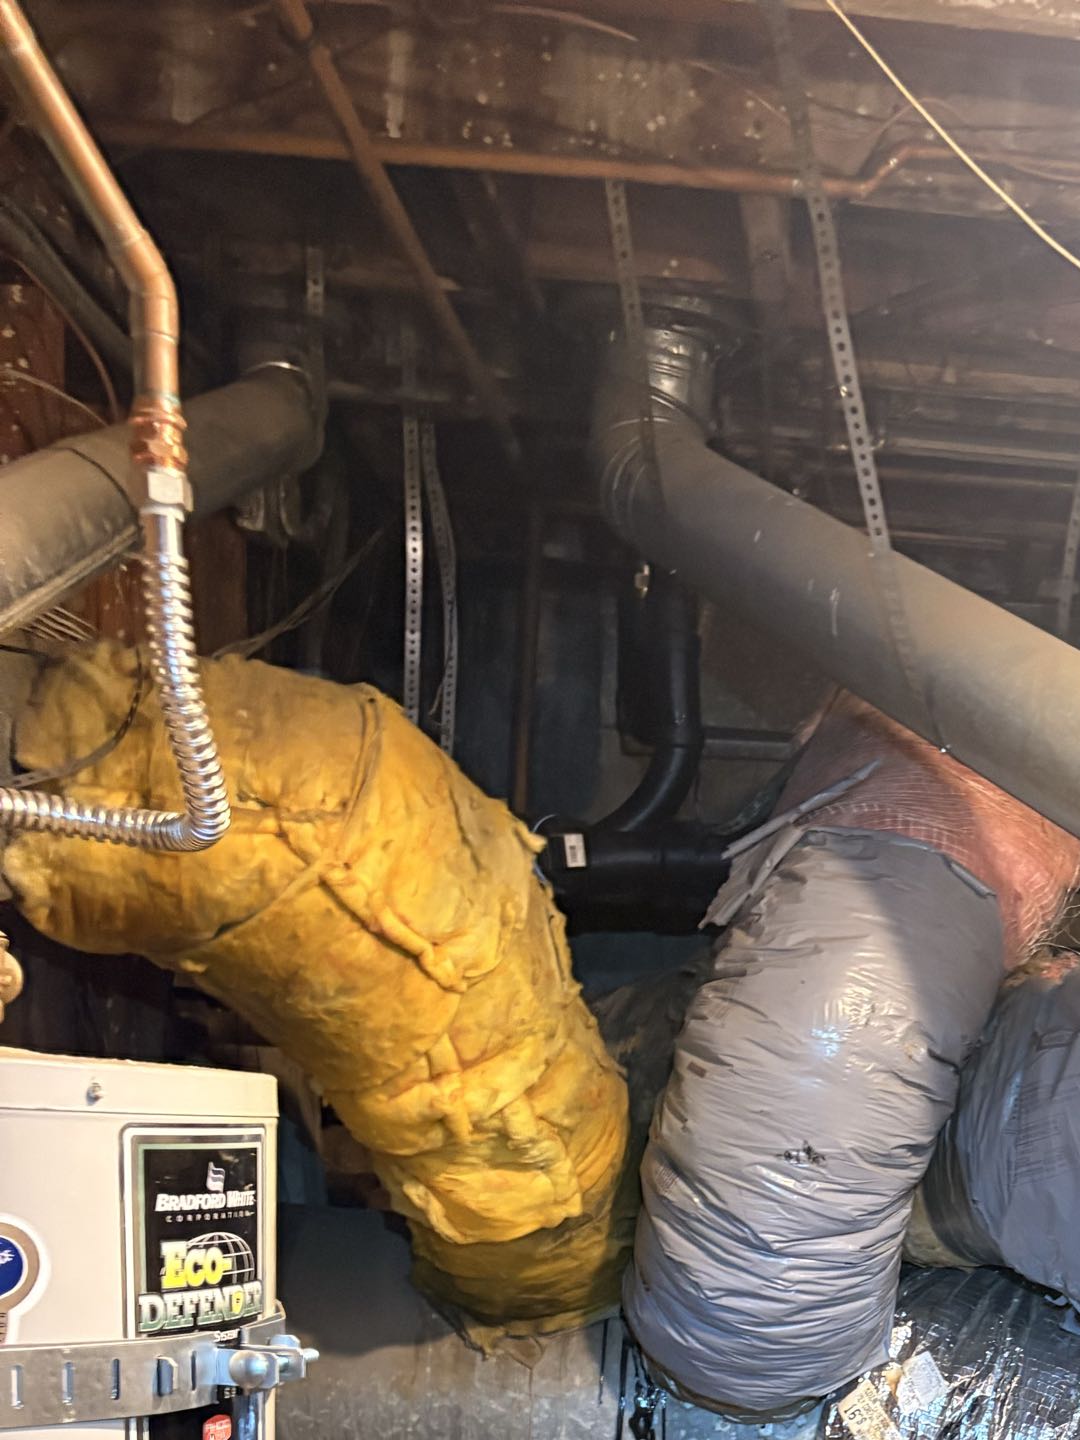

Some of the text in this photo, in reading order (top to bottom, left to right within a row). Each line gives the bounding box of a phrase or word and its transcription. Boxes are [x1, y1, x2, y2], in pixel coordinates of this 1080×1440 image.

[154, 1190, 256, 1212] BRADFORD WHITE
[138, 1280, 263, 1333] DEFENDER
